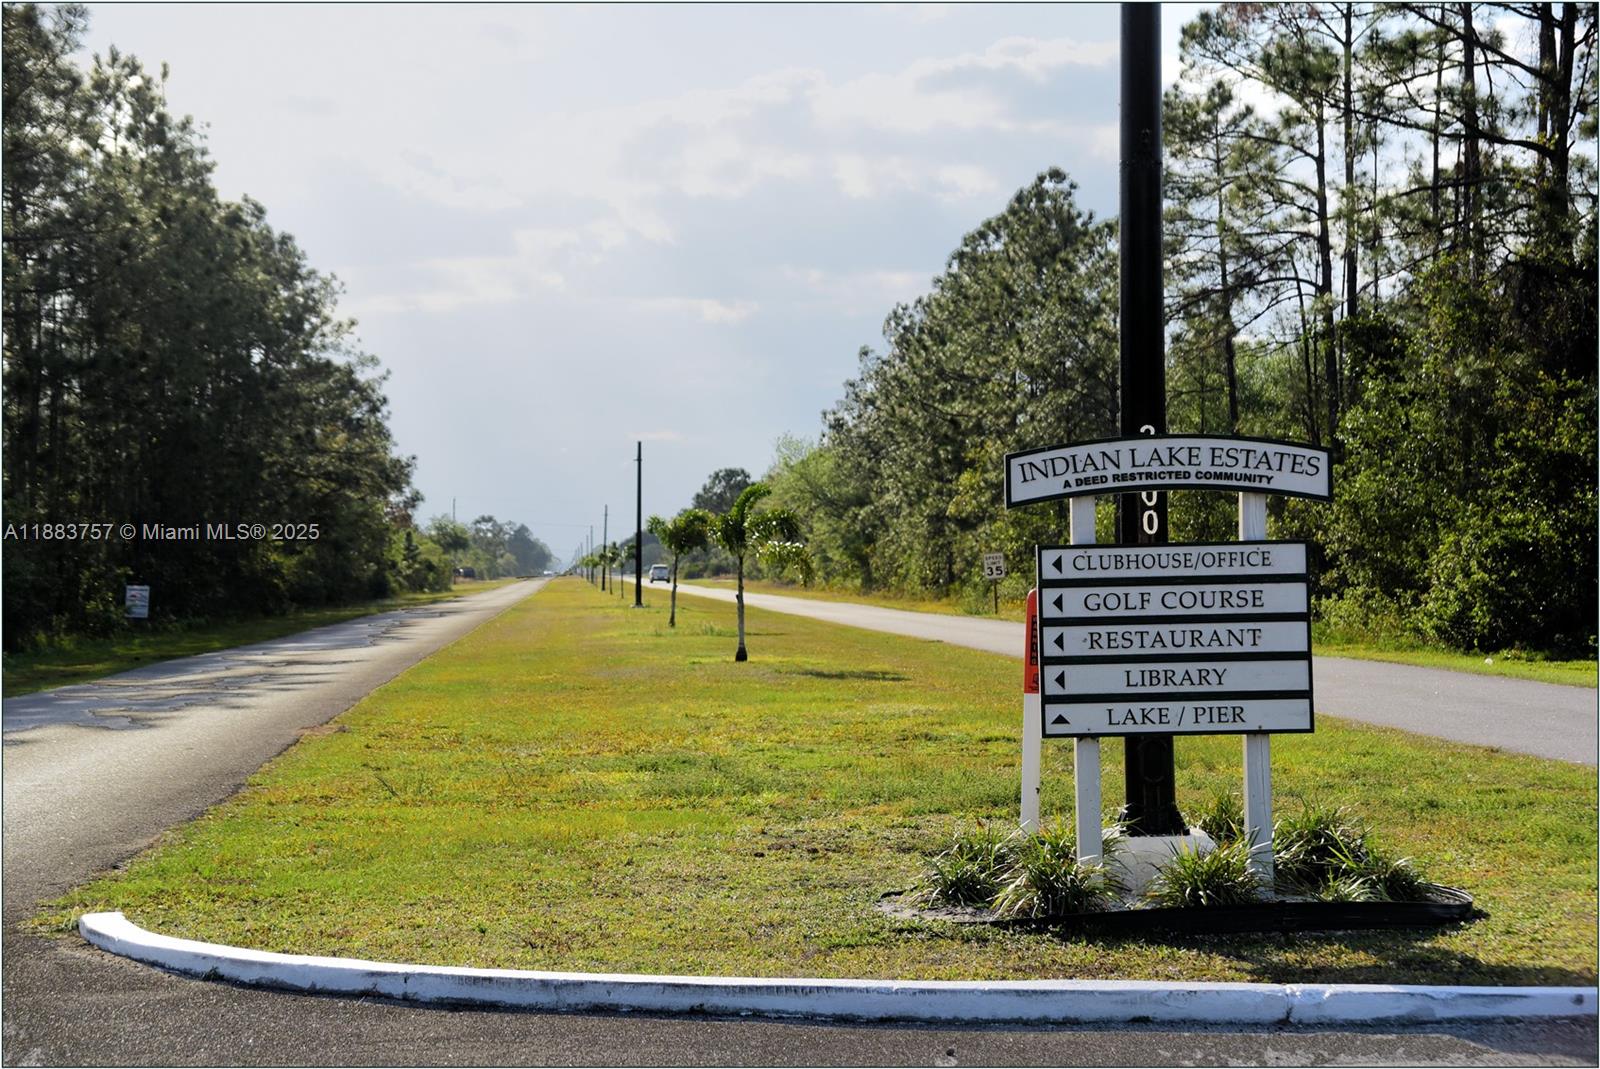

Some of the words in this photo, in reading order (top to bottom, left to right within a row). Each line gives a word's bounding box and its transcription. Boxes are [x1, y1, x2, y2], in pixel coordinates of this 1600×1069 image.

[1018, 450, 1121, 483] INDIAN
[1129, 447, 1201, 469] LAKE
[1210, 447, 1321, 477] ESTATES
[1063, 479, 1072, 489] A
[1075, 474, 1108, 487] DEED
[1112, 470, 1192, 483] RESTRICTED
[1195, 470, 1274, 485] COMMUNITY
[987, 565, 1003, 577] 35
[1072, 550, 1272, 571] CLUBHOUSE/OFFICE
[1083, 592, 1152, 612] GOLF
[1161, 589, 1265, 609] COURSE
[1088, 628, 1262, 650] RESTAURANT
[1125, 668, 1227, 688] LIBRARY
[1106, 707, 1170, 726] LAKE
[1193, 705, 1246, 725] PIER
